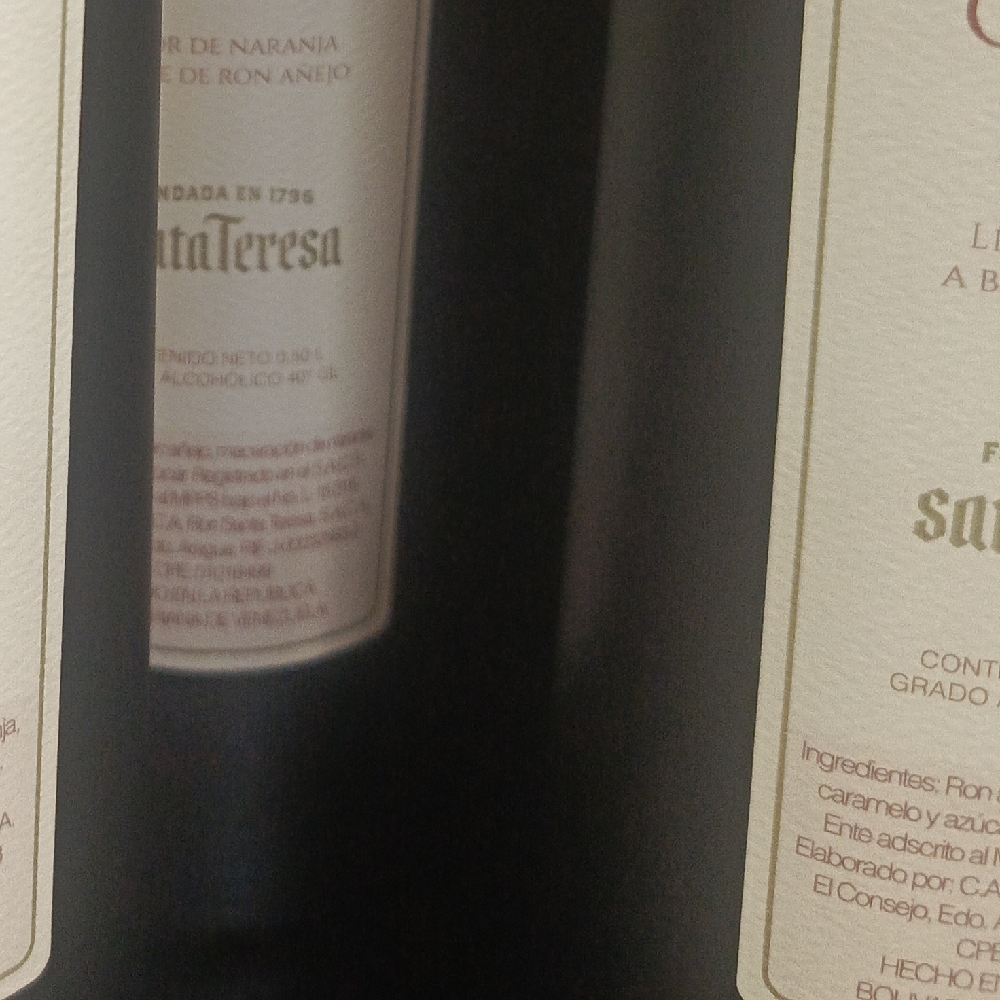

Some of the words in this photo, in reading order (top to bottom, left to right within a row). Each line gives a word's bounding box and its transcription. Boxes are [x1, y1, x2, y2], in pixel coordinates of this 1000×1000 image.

[190, 36, 220, 55] DE
[229, 34, 337, 55] NARANJA
[179, 66, 209, 85] DE
[218, 67, 272, 85] RON
[158, 184, 227, 201] NDADA
[941, 265, 967, 289] A
[889, 672, 989, 706] GRADO
[801, 740, 941, 794] Ingredientes:
[946, 775, 994, 801] Ron
[817, 783, 923, 823] caramelo
[926, 811, 941, 830] y
[944, 812, 1000, 835] azúc
[823, 812, 874, 845] Ente
[876, 831, 966, 863] adscrito
[968, 846, 989, 867] al
[795, 834, 908, 884] Elaborado
[813, 873, 833, 898] El
[837, 880, 932, 923] Consejo,
[956, 938, 1000, 962] CPE
[880, 955, 974, 990] HECHO
